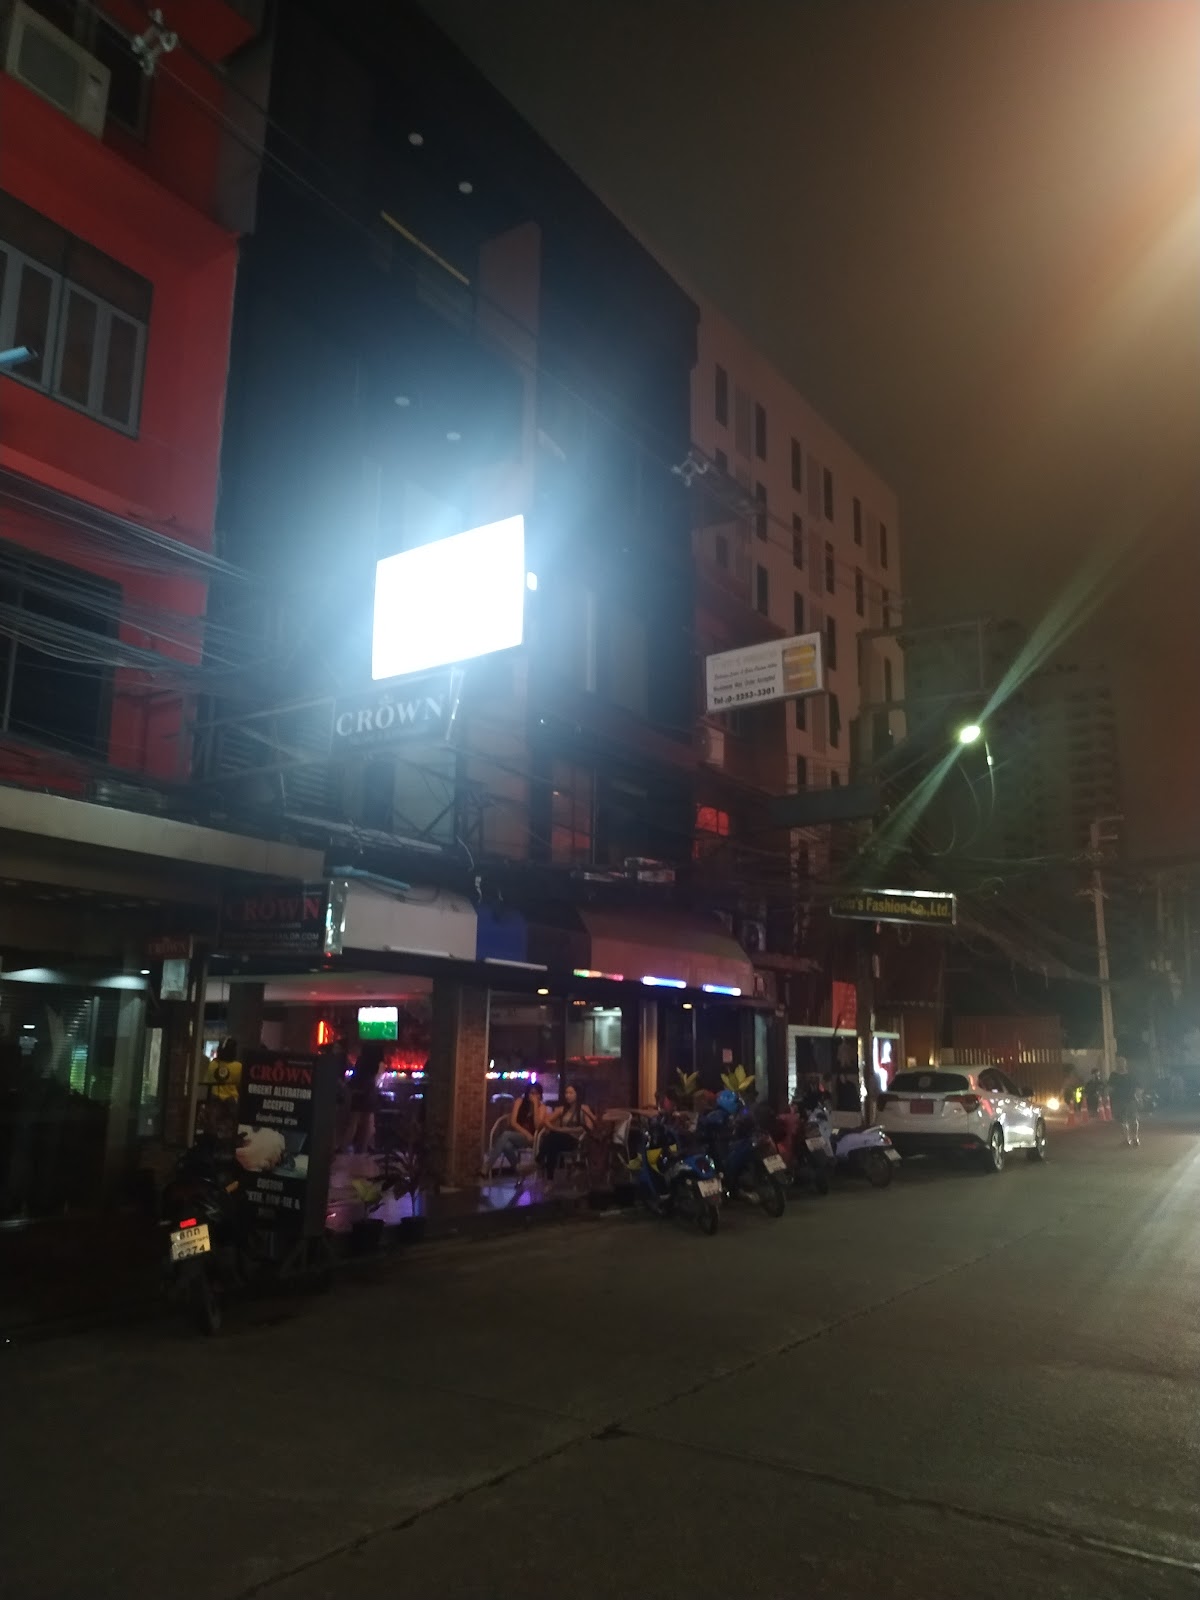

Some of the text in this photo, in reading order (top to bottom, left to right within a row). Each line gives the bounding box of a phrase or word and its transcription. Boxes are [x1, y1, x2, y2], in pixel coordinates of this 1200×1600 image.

[336, 695, 444, 736] CROWN
[224, 897, 320, 921] CROWN
[866, 897, 907, 914] Fashion
[249, 1064, 313, 1085] CROWN
[248, 1083, 312, 1101] URGENT ALTERATION
[262, 1099, 295, 1113] ACCEPTED
